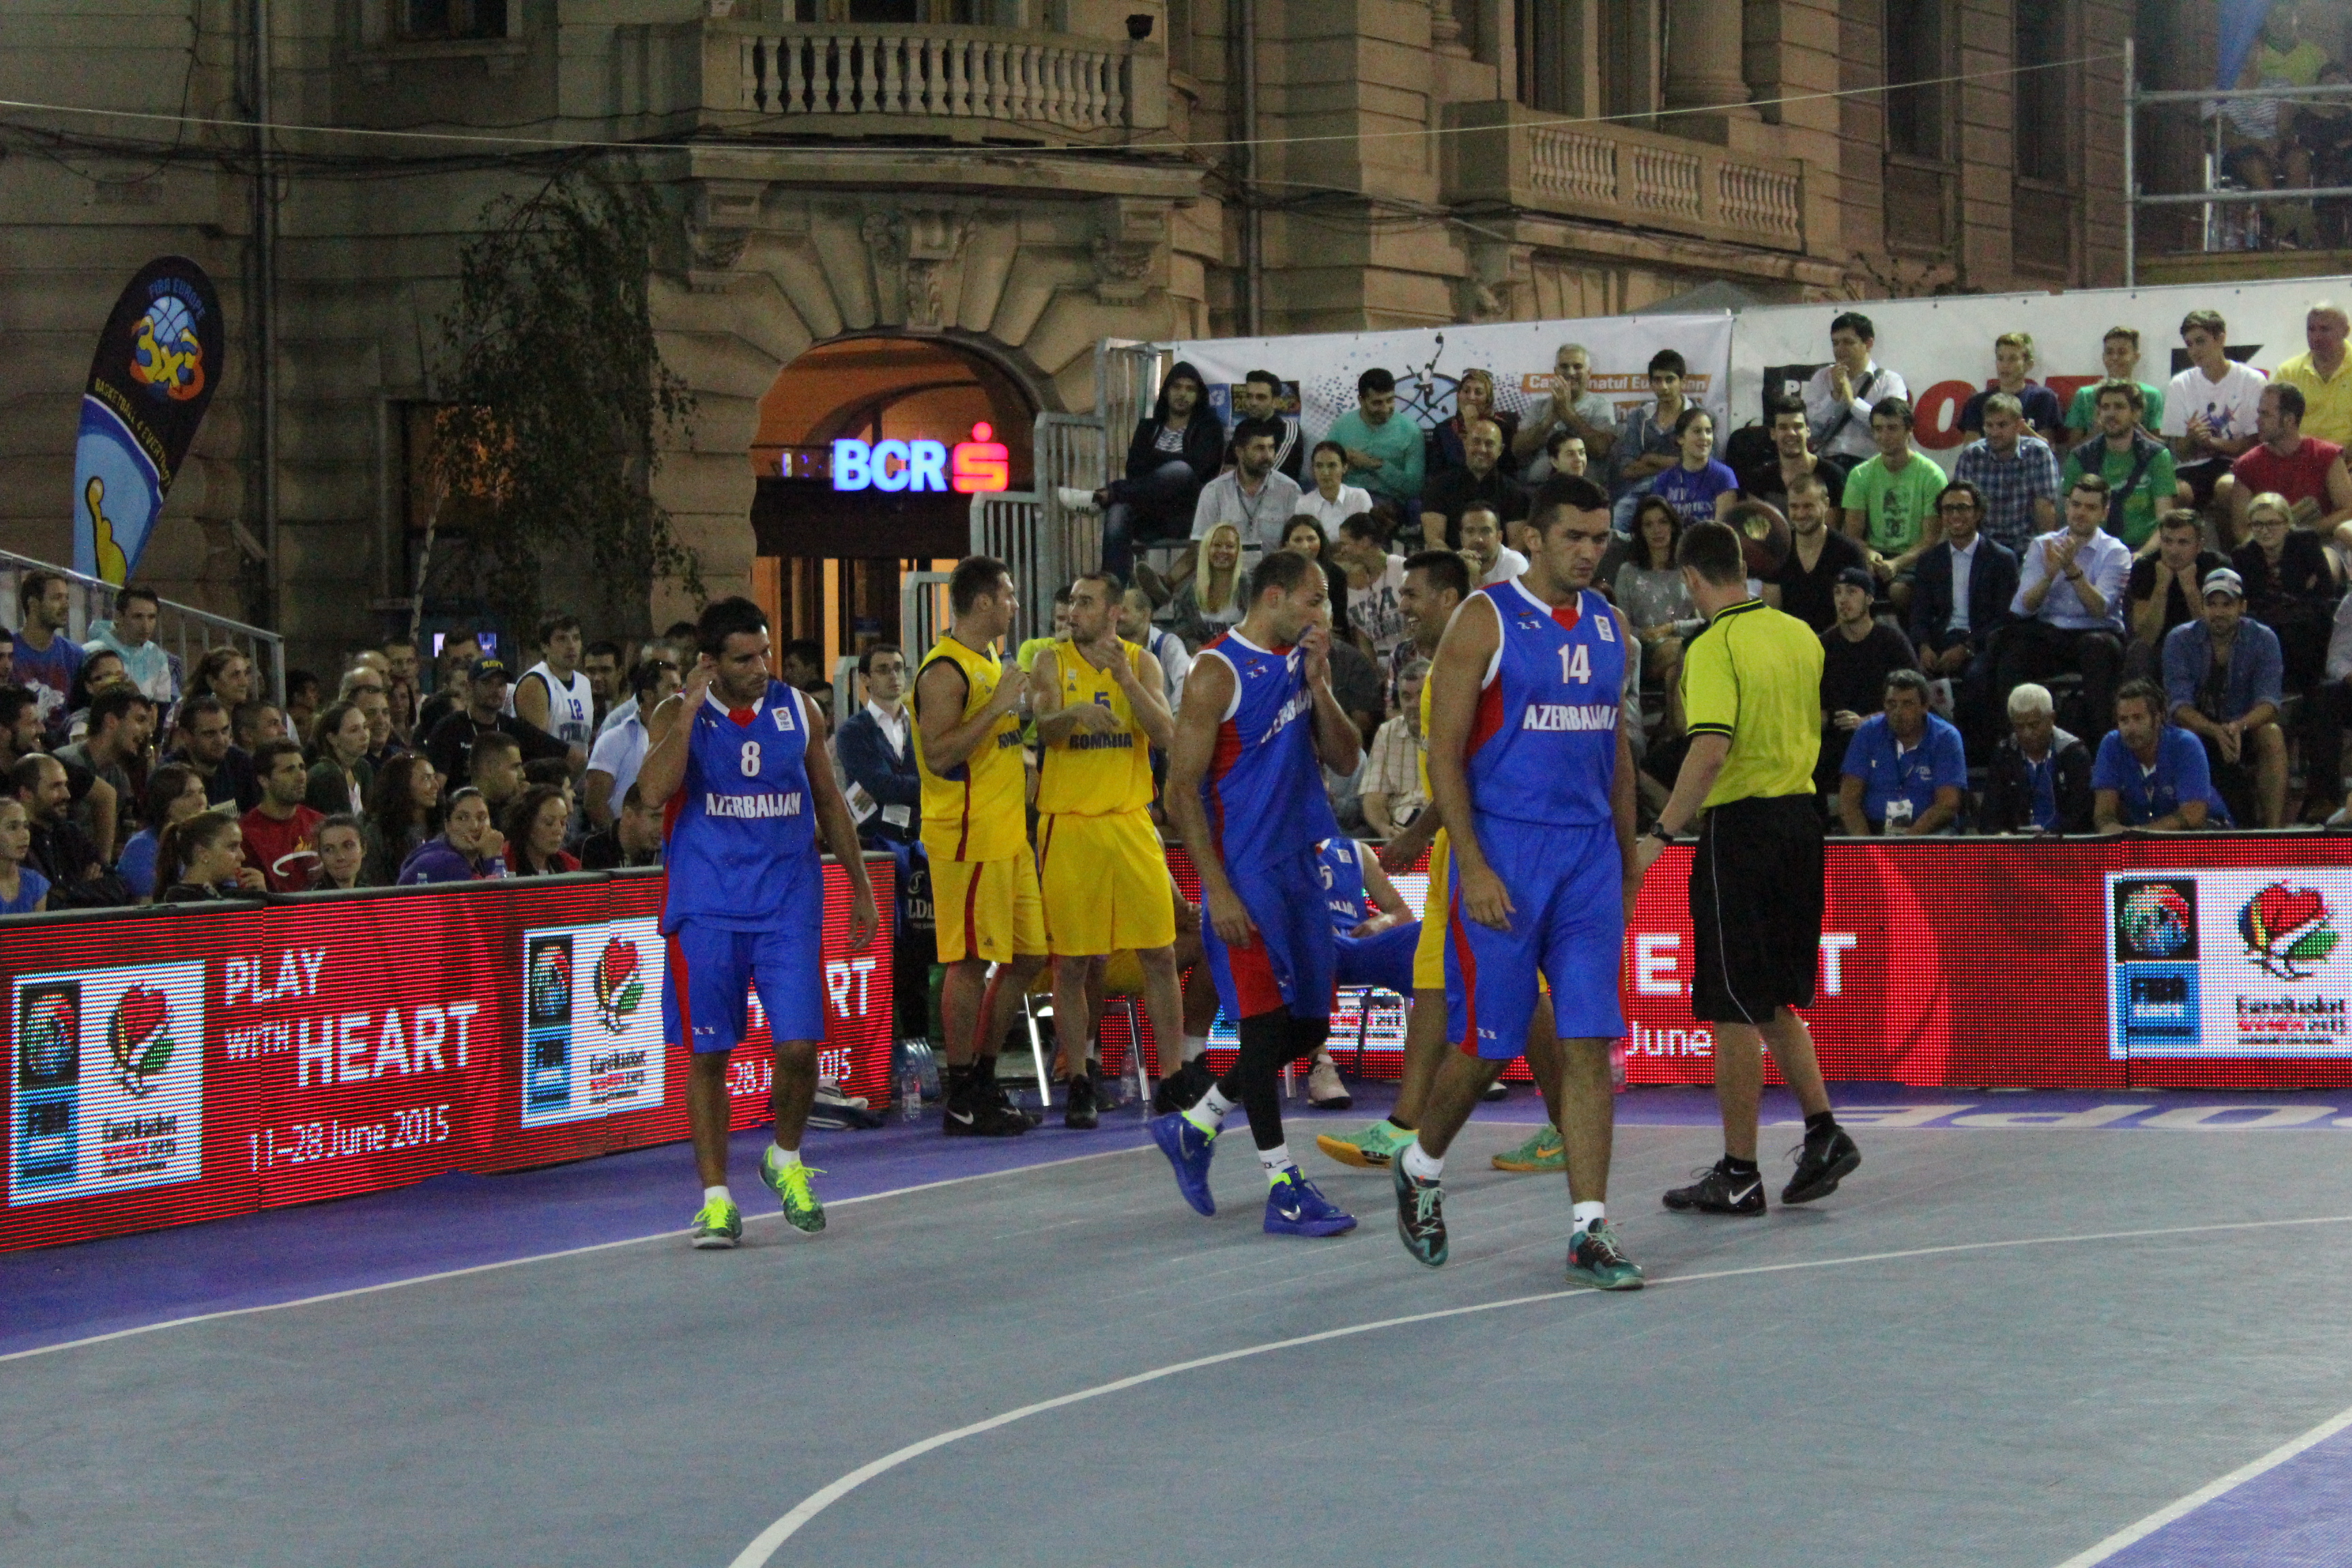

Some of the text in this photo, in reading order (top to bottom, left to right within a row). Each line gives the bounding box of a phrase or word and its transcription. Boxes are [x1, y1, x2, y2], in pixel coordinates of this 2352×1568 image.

[149, 278, 205, 320] FIBA EUROPE
[95, 378, 137, 423] BASKETBALL
[1529, 375, 1706, 391] Canatul Euan
[833, 438, 948, 492] BCR
[1558, 643, 1592, 685] 14
[567, 698, 585, 720] 12
[740, 740, 761, 777] 8
[706, 791, 802, 819] AZERBAIJAN
[225, 947, 326, 1006] PLAY
[225, 1020, 289, 1060] WITH
[298, 1000, 478, 1088] HEART
[1624, 1020, 1712, 1056] June
[725, 1060, 755, 1096] -28
[817, 1047, 851, 1081] 015
[250, 1104, 450, 1172] 11-28 June 2015
